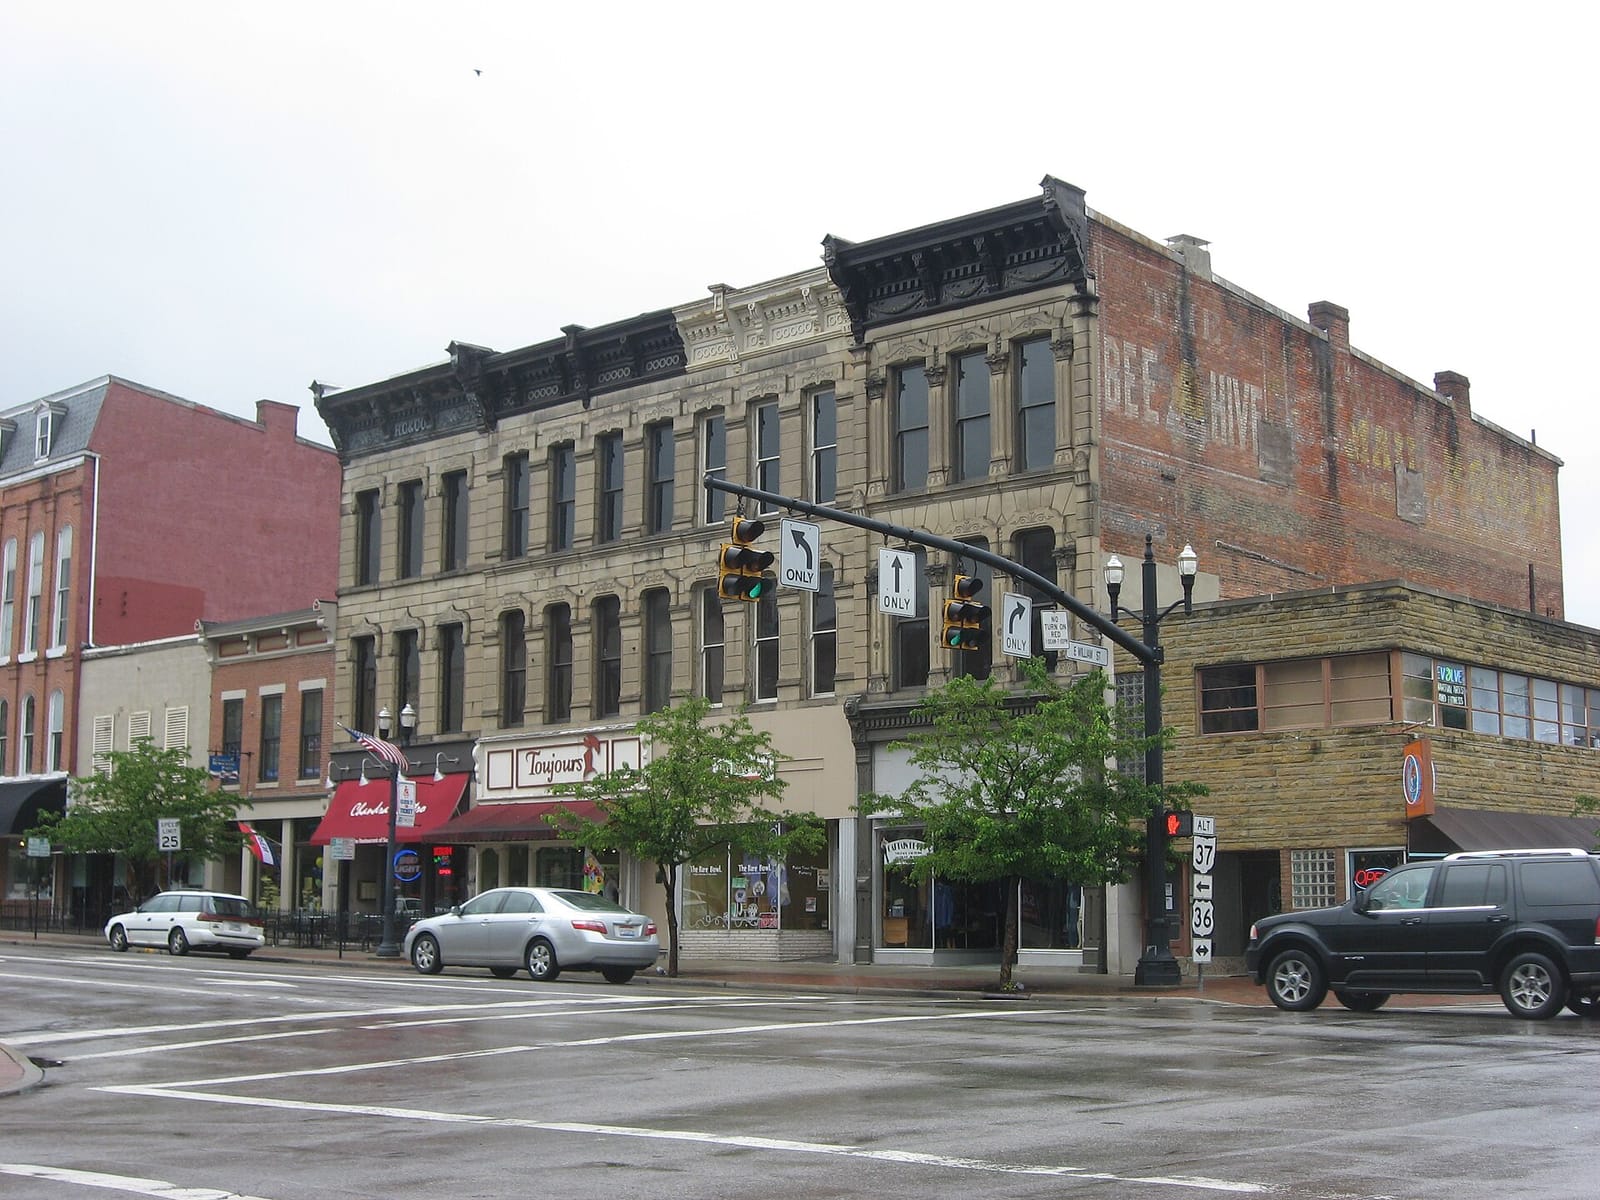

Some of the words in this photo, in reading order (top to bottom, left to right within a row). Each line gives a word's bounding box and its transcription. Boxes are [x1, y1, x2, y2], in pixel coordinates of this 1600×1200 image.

[786, 568, 814, 584] ONLY
[884, 595, 911, 610] ONLY
[1044, 623, 1058, 631] TURN
[1059, 623, 1067, 631] ON
[1006, 637, 1027, 651] ONLY
[525, 750, 583, 783] Toujours
[1197, 820, 1210, 831] ALT
[162, 835, 178, 848] 25
[1195, 844, 1213, 866] 37
[689, 864, 698, 873] The
[738, 864, 747, 872] The
[1355, 869, 1385, 886] OPE
[1194, 907, 1212, 928] 36
